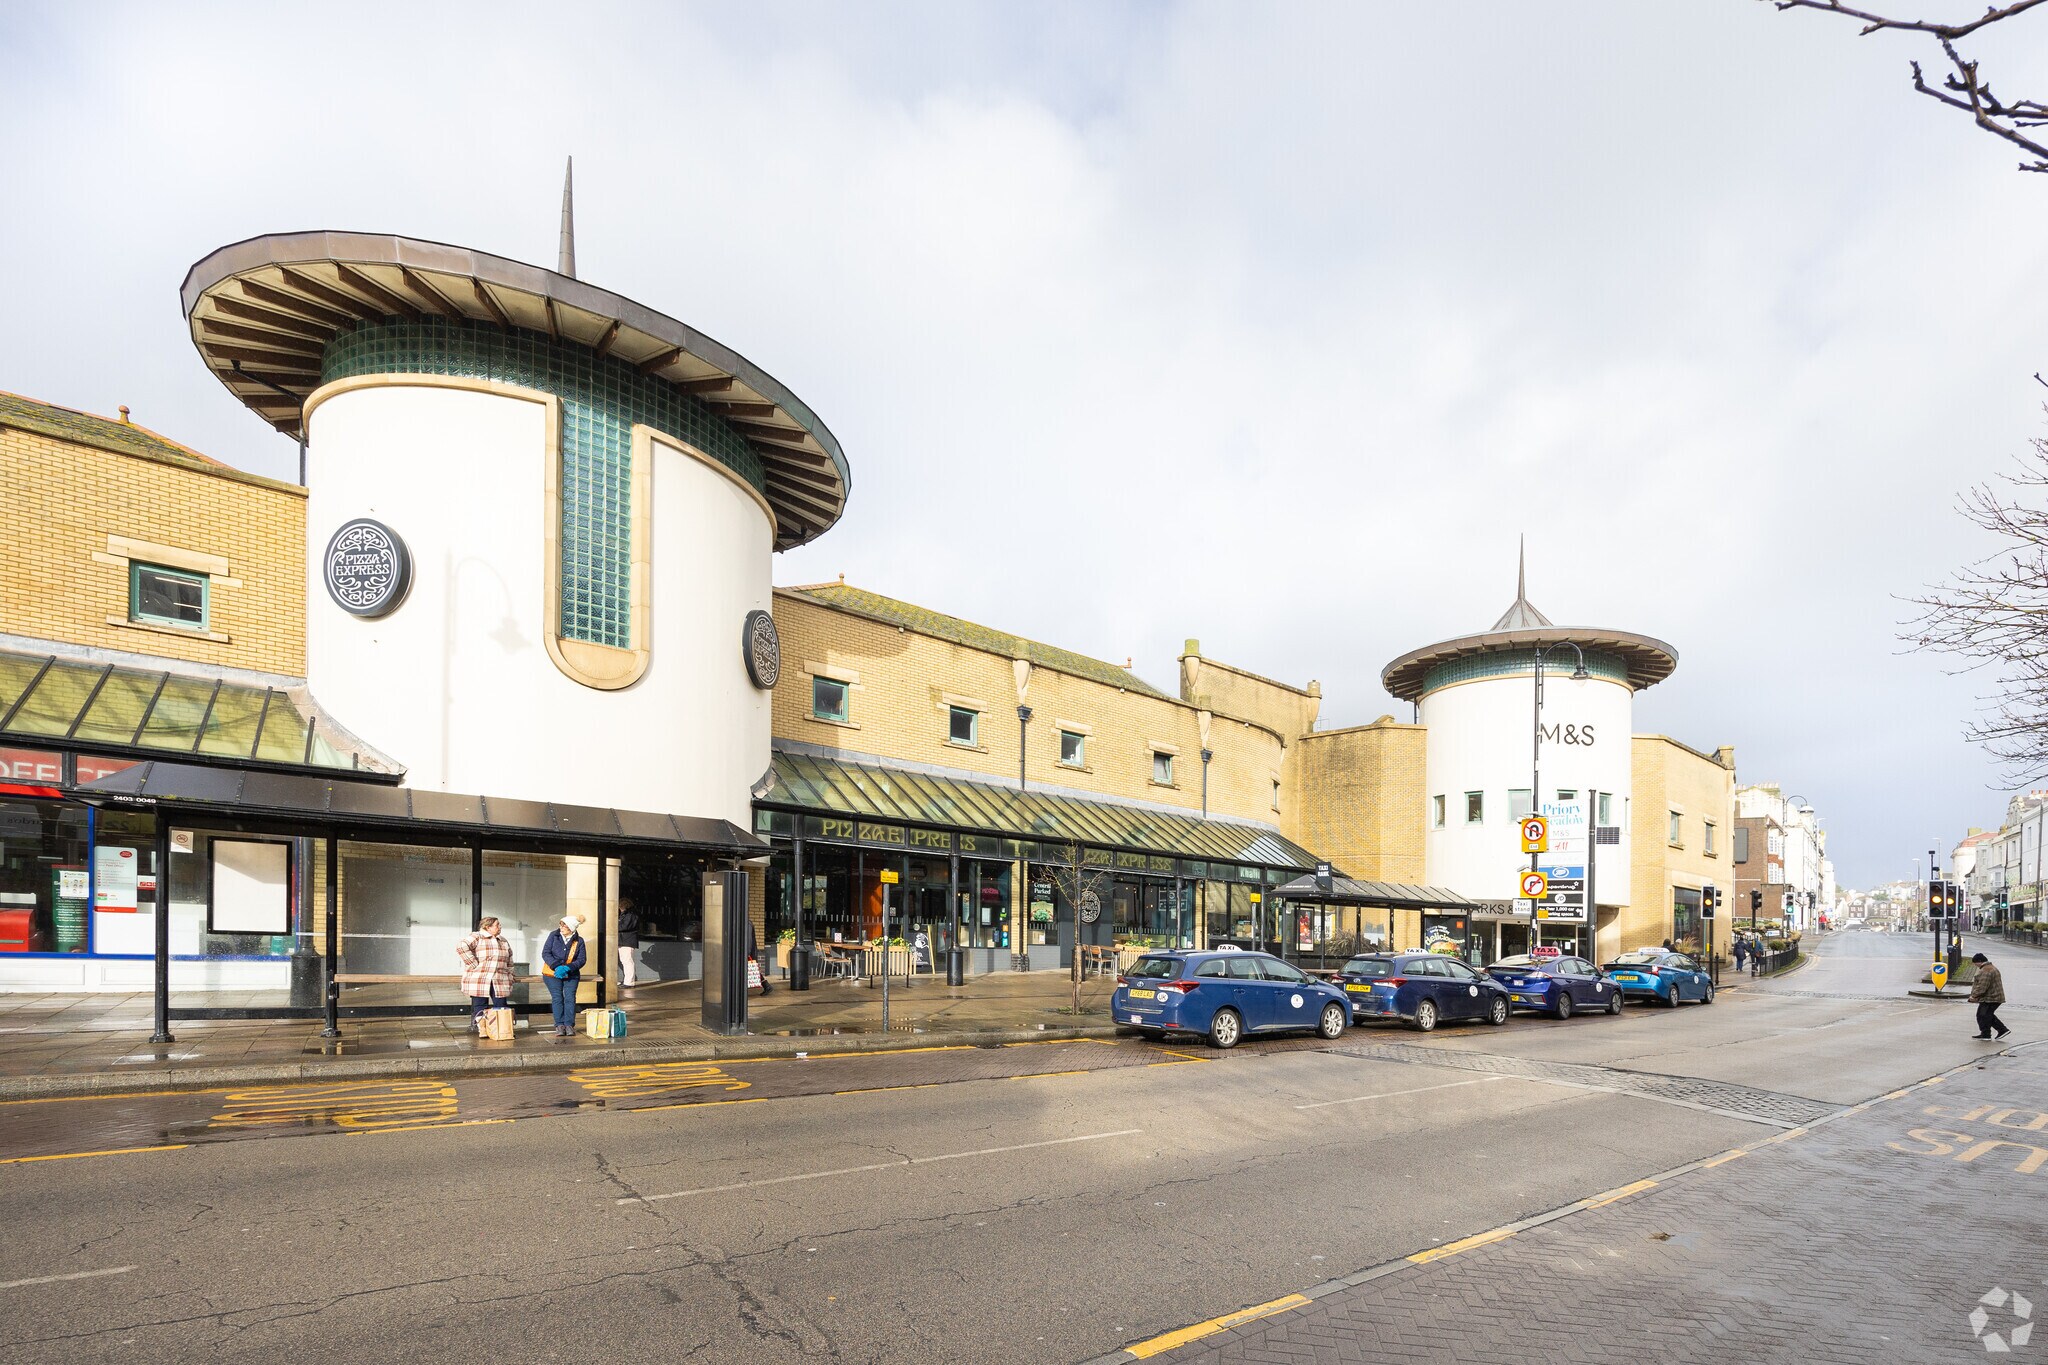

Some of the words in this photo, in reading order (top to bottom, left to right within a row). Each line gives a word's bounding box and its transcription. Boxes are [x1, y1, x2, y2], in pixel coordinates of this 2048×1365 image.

[345, 554, 380, 565] PIZZA
[335, 564, 390, 576] EXPRESS
[1540, 722, 1595, 747] M&S
[1543, 803, 1581, 816] Priory
[1550, 814, 1583, 825] eadow
[822, 819, 885, 842] PIZZA
[1117, 852, 1172, 871] XPRESS
[1536, 946, 1558, 954] TAXI
[1885, 1127, 2048, 1174] US
